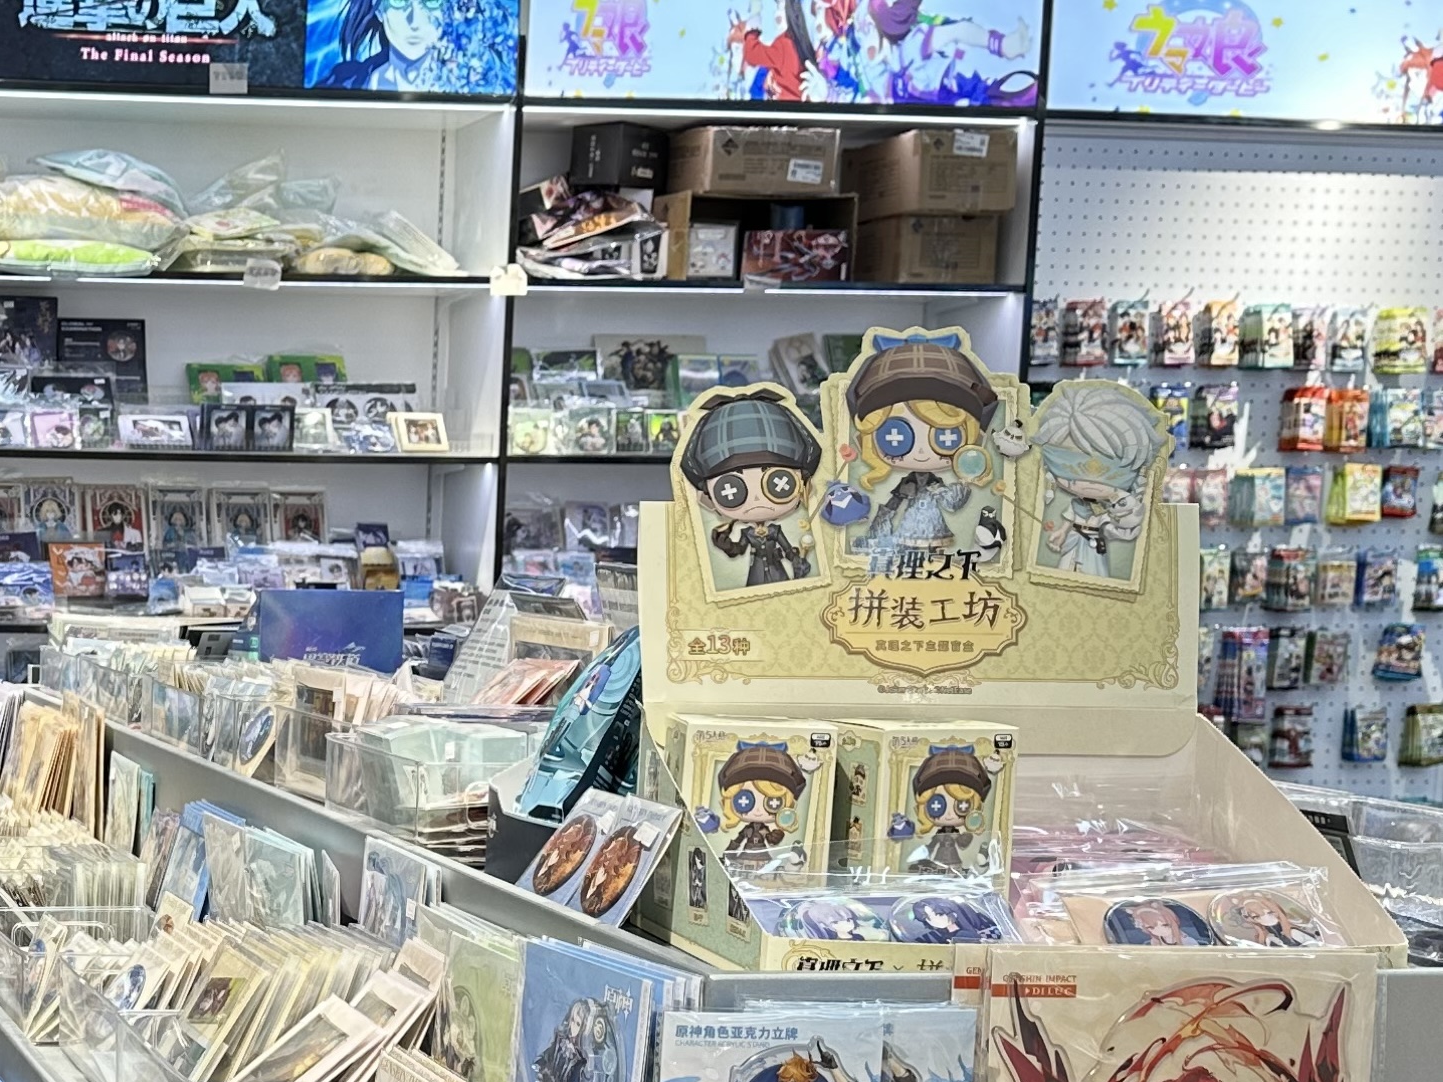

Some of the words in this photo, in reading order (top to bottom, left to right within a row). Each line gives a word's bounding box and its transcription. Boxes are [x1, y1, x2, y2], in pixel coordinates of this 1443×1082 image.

[80, 46, 108, 61] The
[114, 49, 154, 63] Final
[159, 49, 211, 64] Season
[868, 548, 983, 581] 真理之下
[847, 587, 1005, 631] 拼装工坊
[687, 633, 751, 657] 全13种
[1045, 974, 1077, 983] IMPACT
[675, 1025, 799, 1041] 原神角色亚克力立牌
